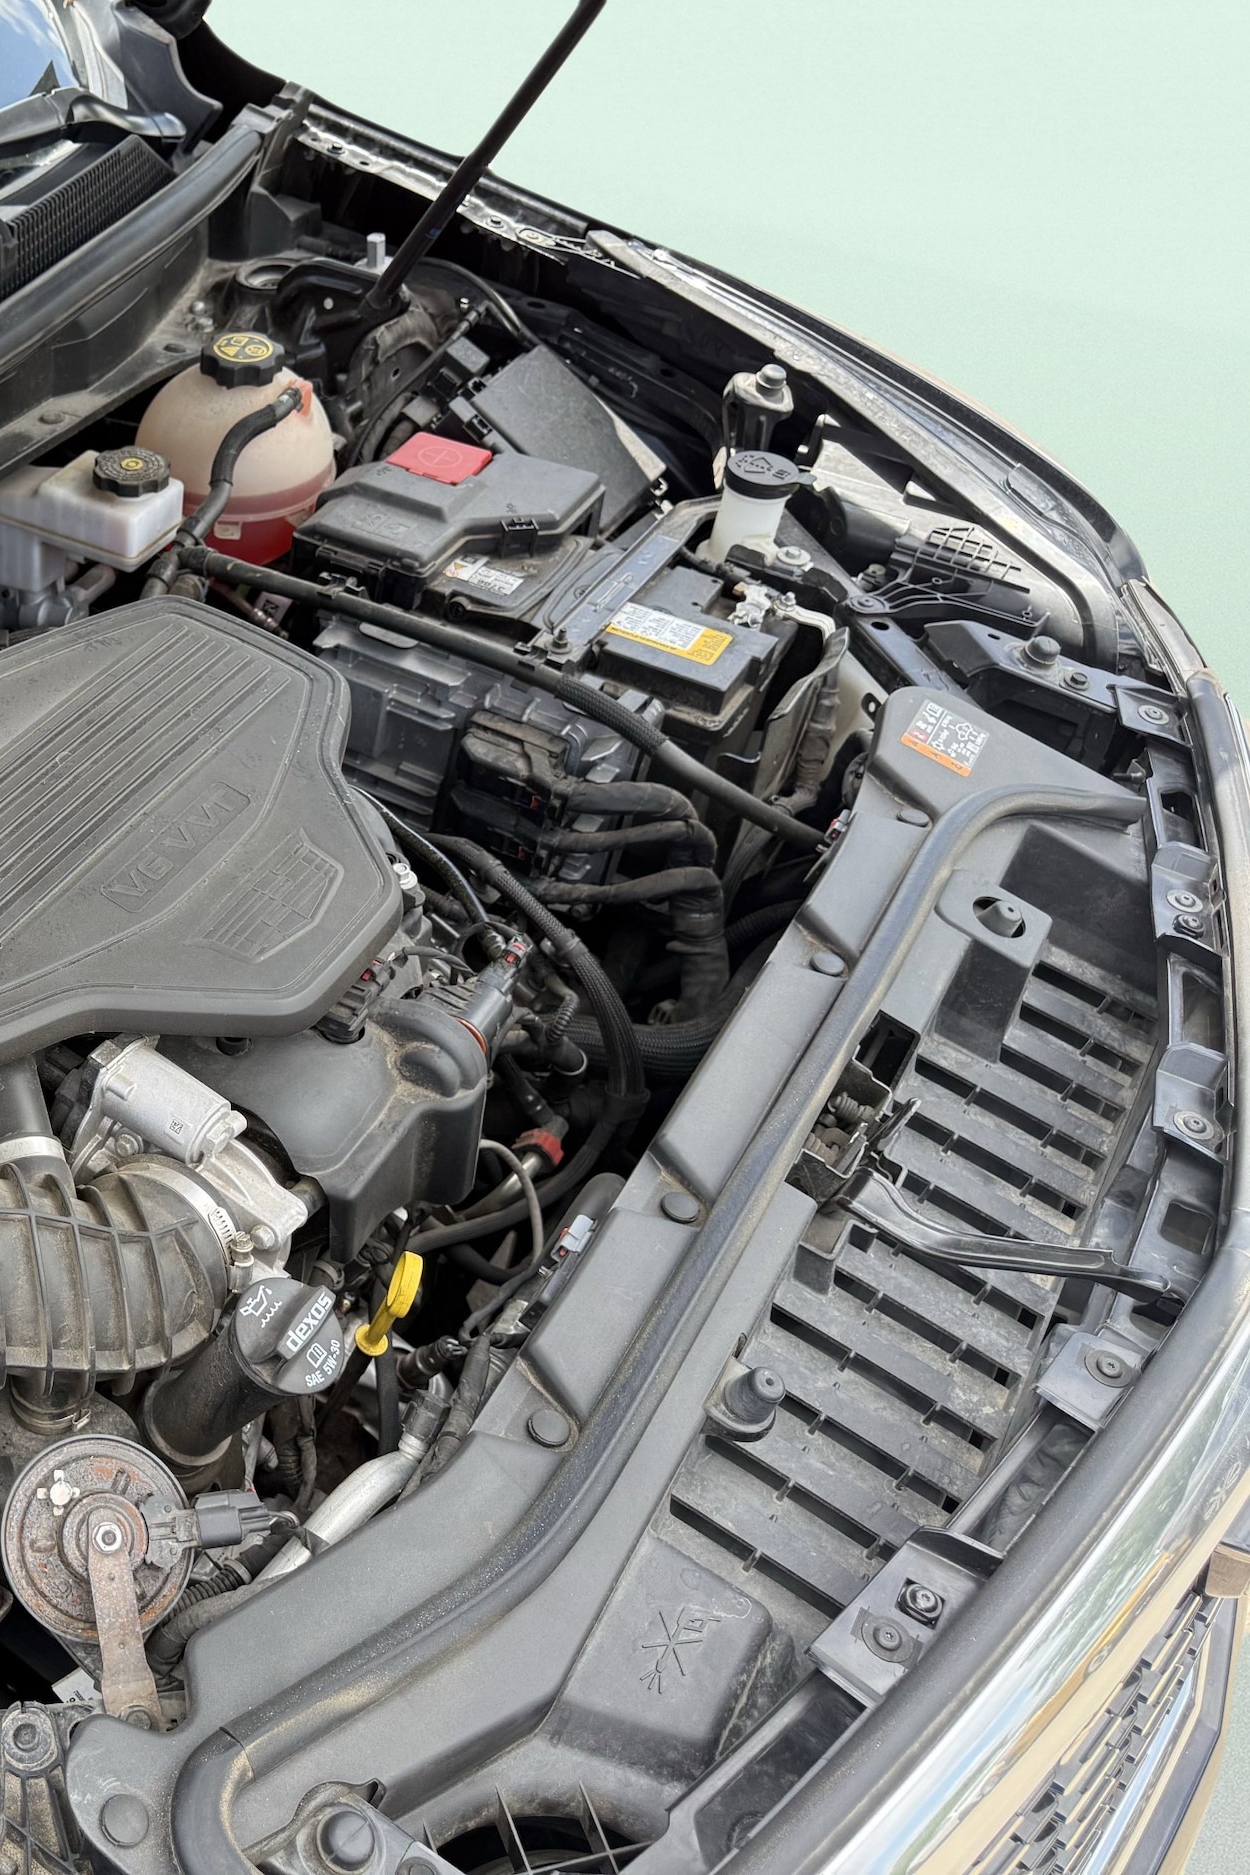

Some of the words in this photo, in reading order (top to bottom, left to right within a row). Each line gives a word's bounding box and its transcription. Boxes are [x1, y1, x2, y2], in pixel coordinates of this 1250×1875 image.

[107, 851, 174, 897] V6
[286, 1291, 332, 1352] dexos
[305, 1370, 325, 1387] SAE
[323, 1339, 341, 1375] 5W-30
